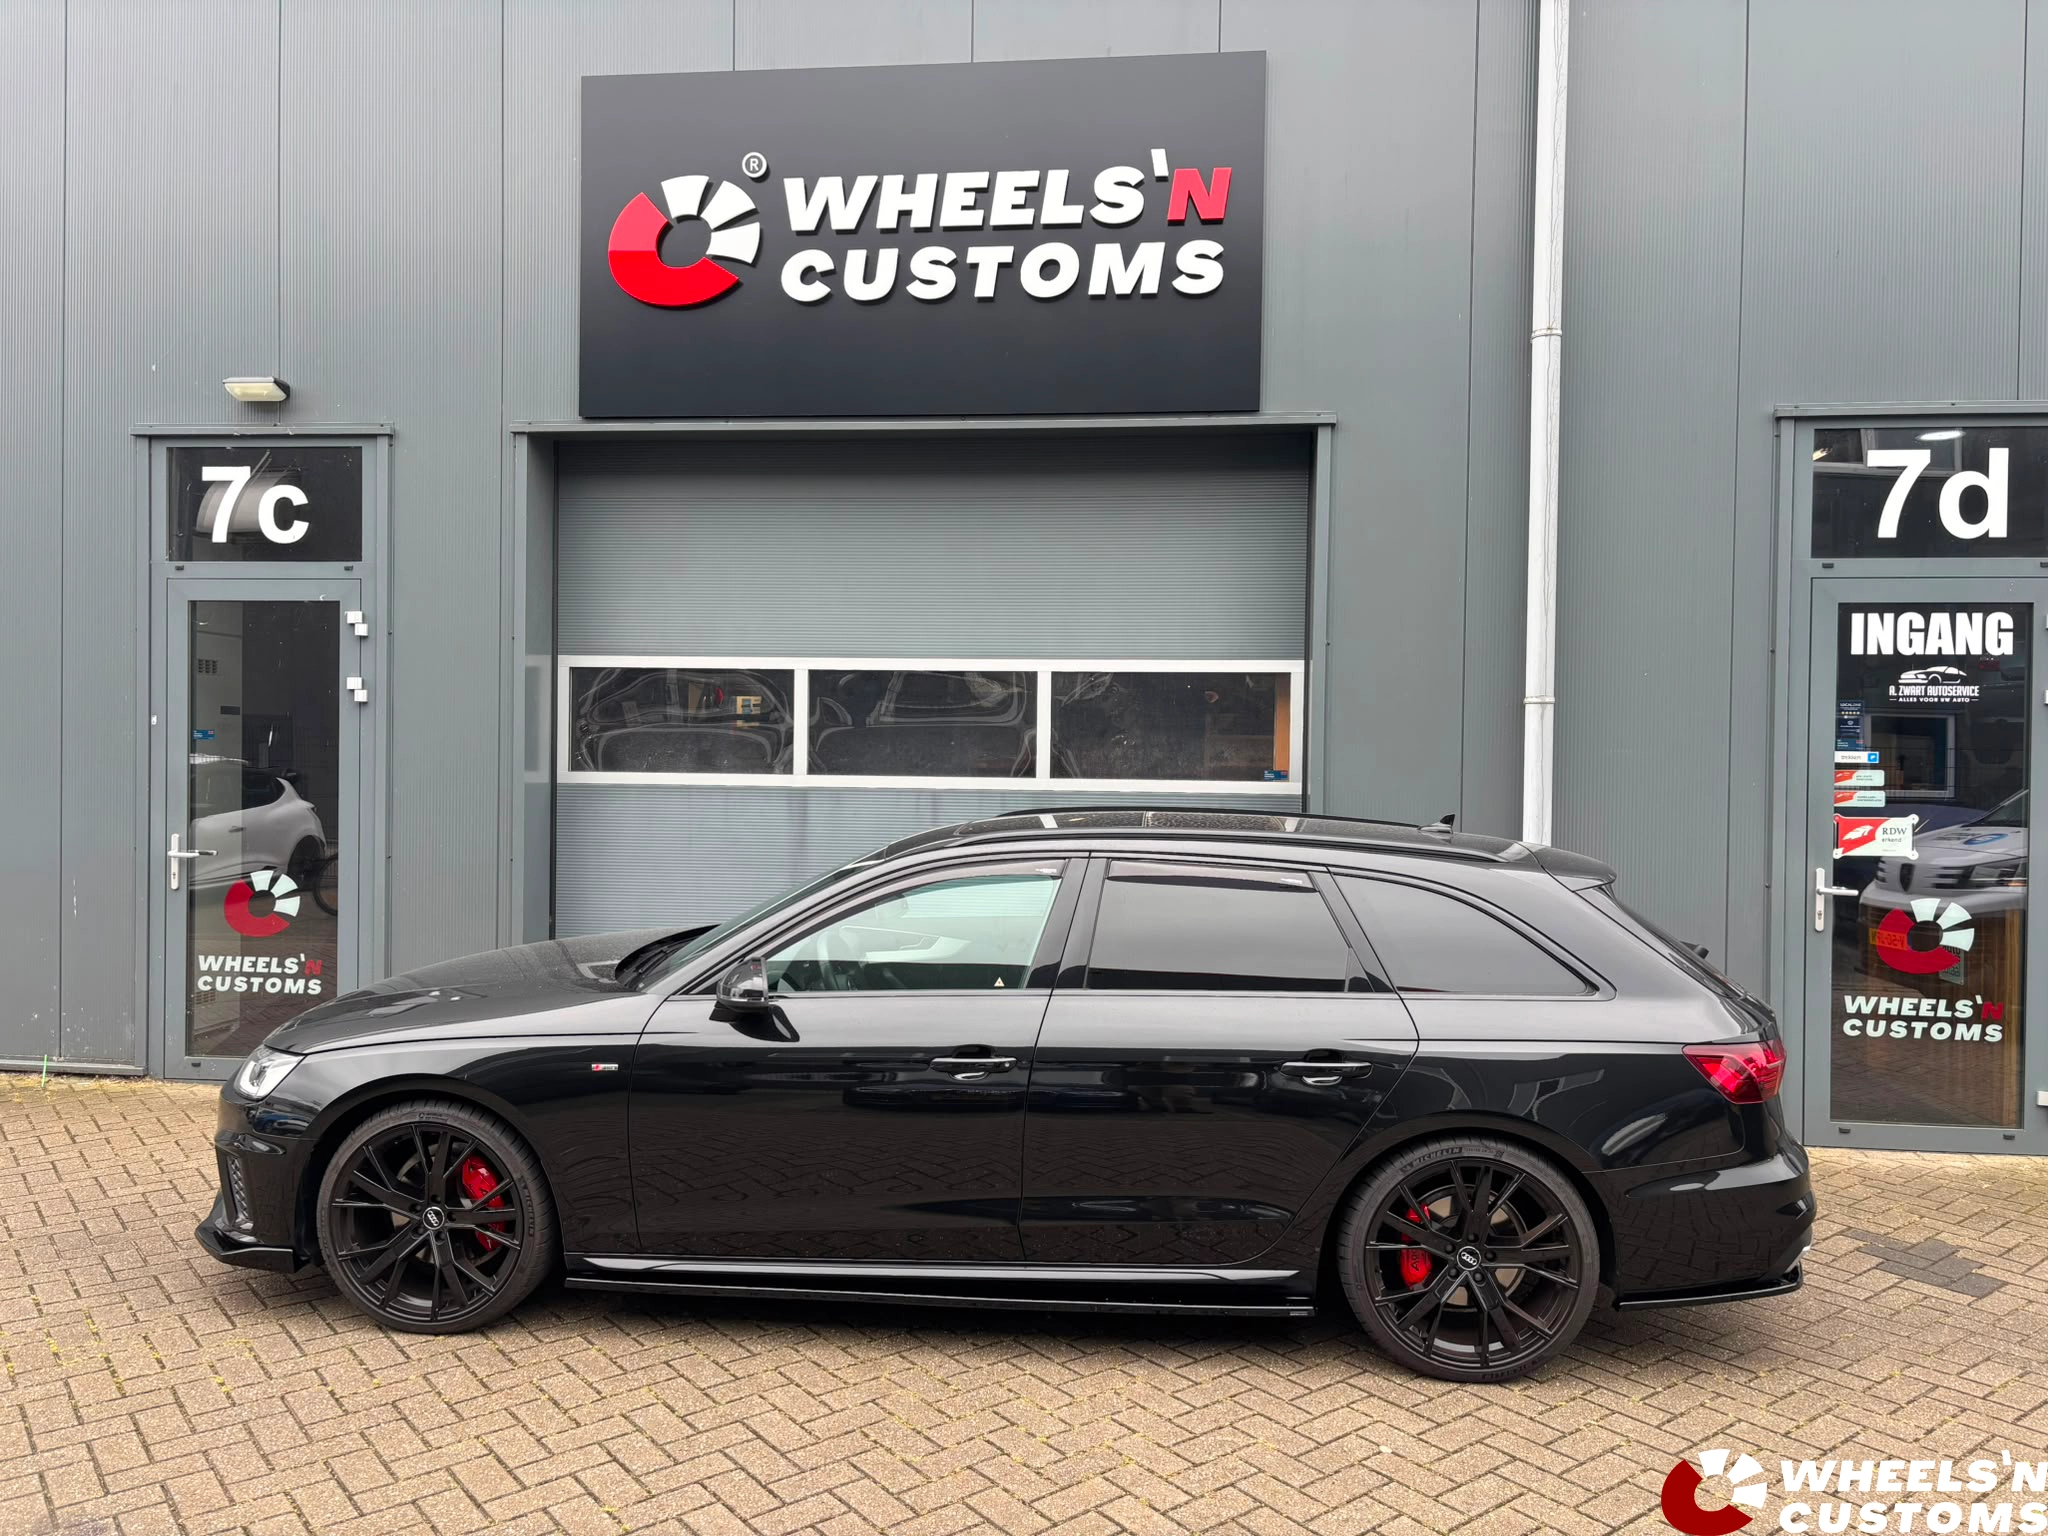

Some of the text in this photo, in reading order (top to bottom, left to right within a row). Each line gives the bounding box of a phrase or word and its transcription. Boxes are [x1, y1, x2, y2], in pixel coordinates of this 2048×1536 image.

[783, 148, 1233, 232] WHEELS'N
[780, 239, 1225, 303] CUSTOMS
[201, 466, 310, 545] 7c
[1866, 447, 2010, 540] 7d
[1850, 611, 2015, 657] INGANG
[1898, 685, 1926, 697] ZWART
[1926, 685, 1980, 697] AUTOSERVICE
[1882, 827, 1908, 836] RDW
[197, 953, 322, 976] WHEELS'N
[197, 976, 322, 995] CUSTOMS
[1843, 994, 2003, 1020] WHEELS'N
[1842, 1019, 2003, 1043] CUSTOMS
